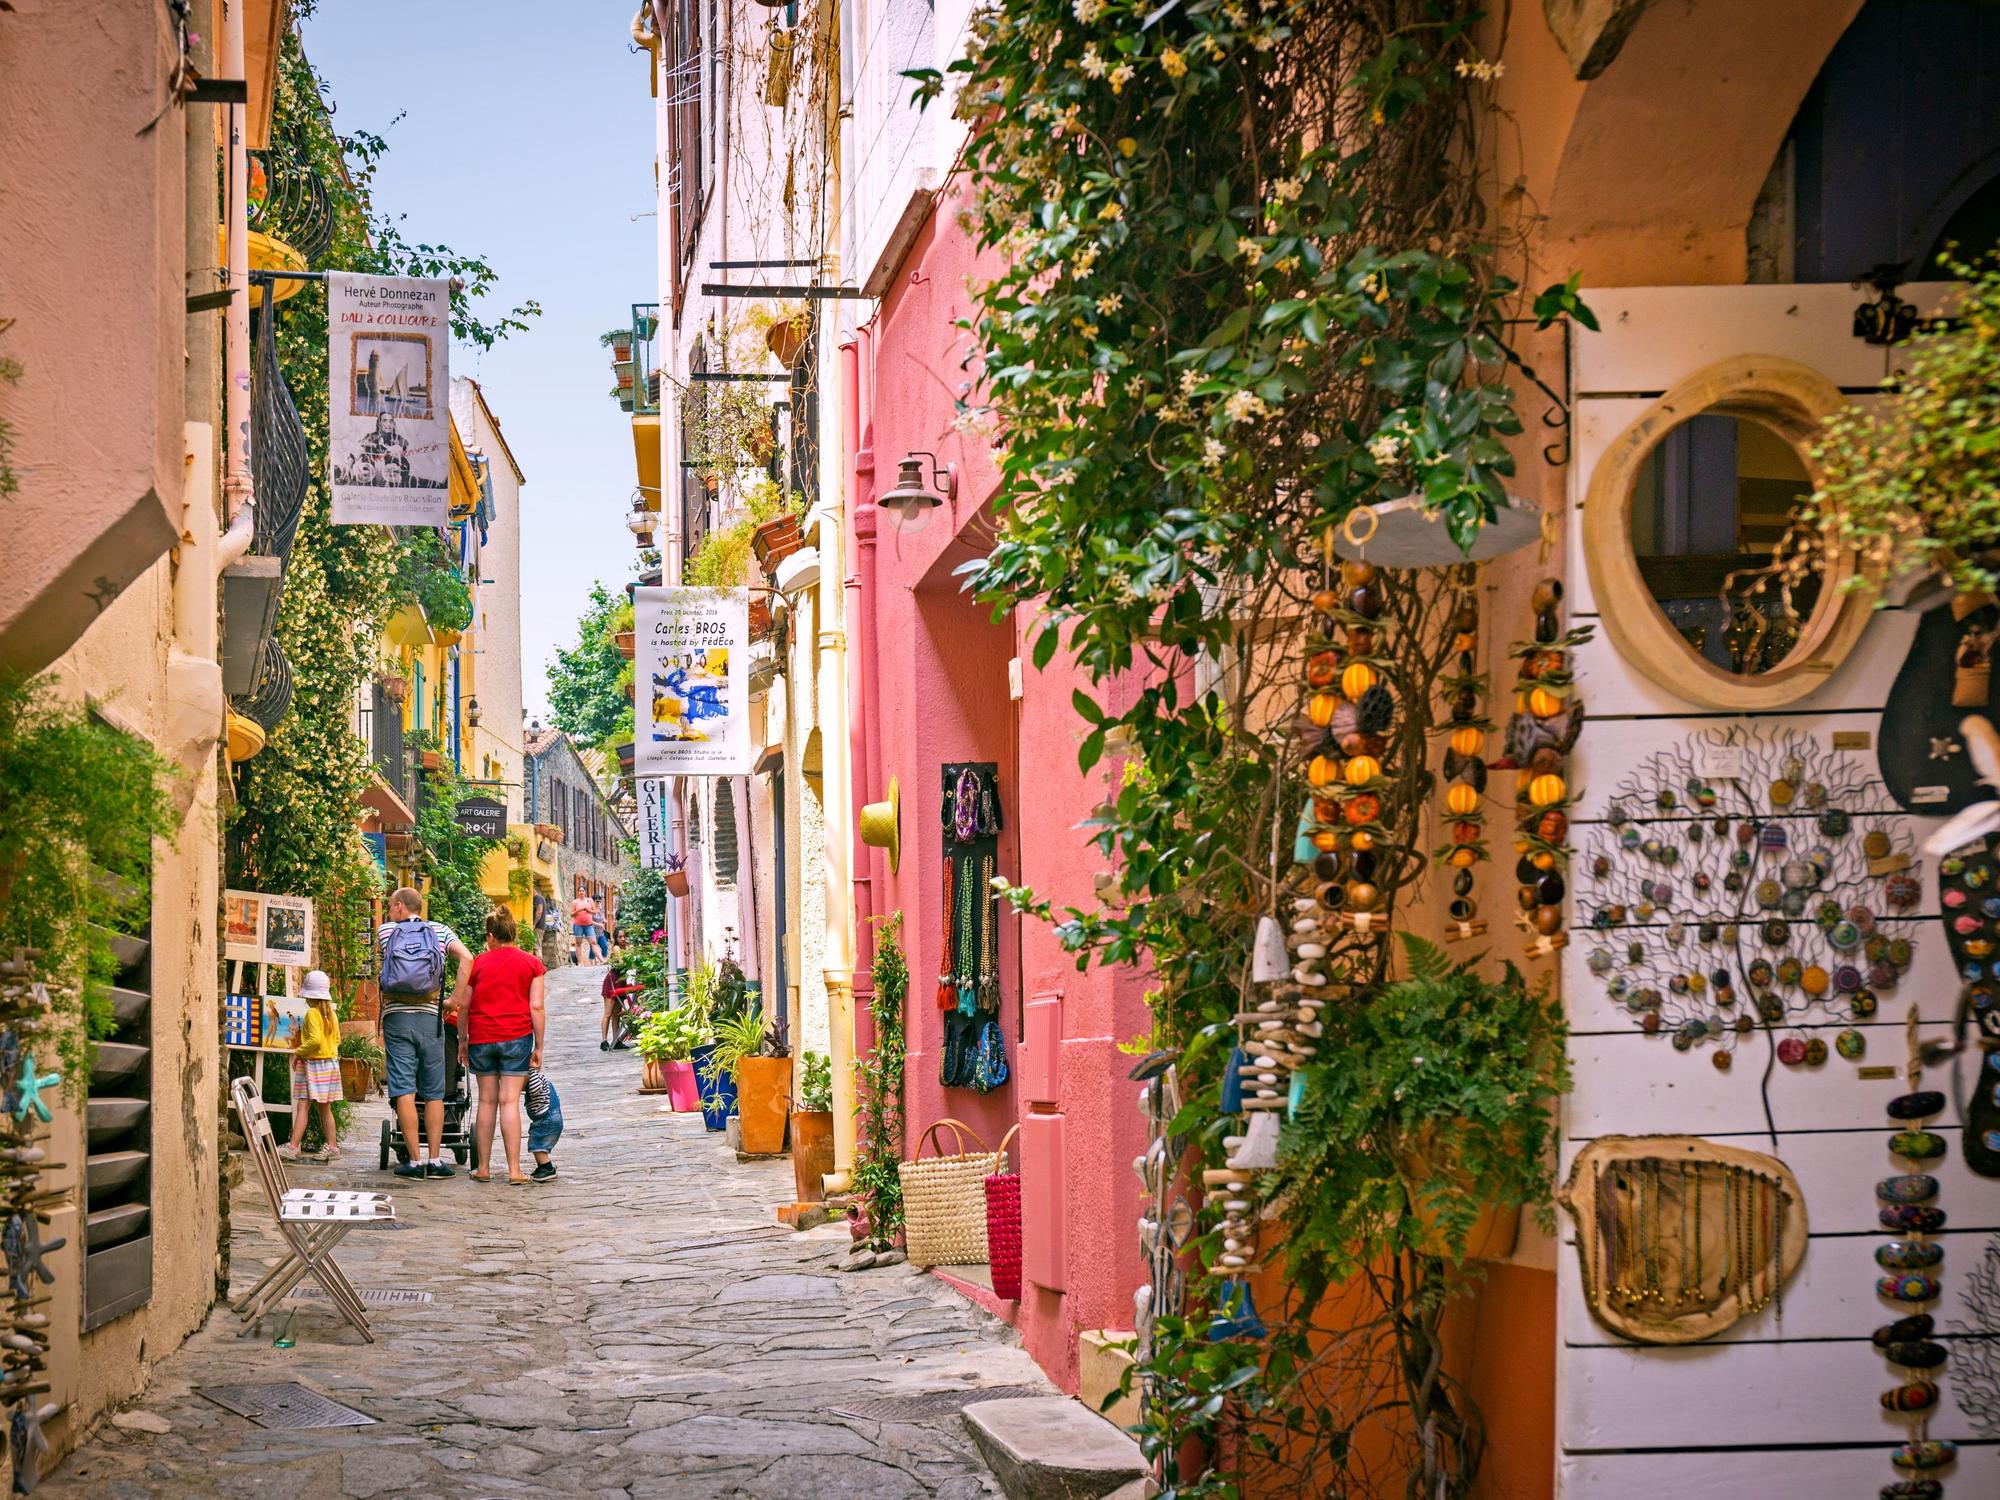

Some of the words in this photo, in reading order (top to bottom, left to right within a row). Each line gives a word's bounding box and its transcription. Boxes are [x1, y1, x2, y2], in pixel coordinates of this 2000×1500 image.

[344, 286, 376, 298] Hervé
[380, 287, 436, 301] Donnezan
[382, 301, 423, 311] Photographe
[376, 314, 438, 326] COLLIOURE
[404, 494, 442, 504] Roussillon
[655, 622, 690, 634] Carles
[695, 622, 726, 634] BROS
[651, 638, 658, 646] is
[660, 638, 687, 646] hosted
[689, 639, 699, 647] by
[701, 634, 734, 646] FédÉco
[460, 808, 473, 816] ART
[473, 809, 501, 817] GALERIE
[643, 779, 662, 869] GALERIE
